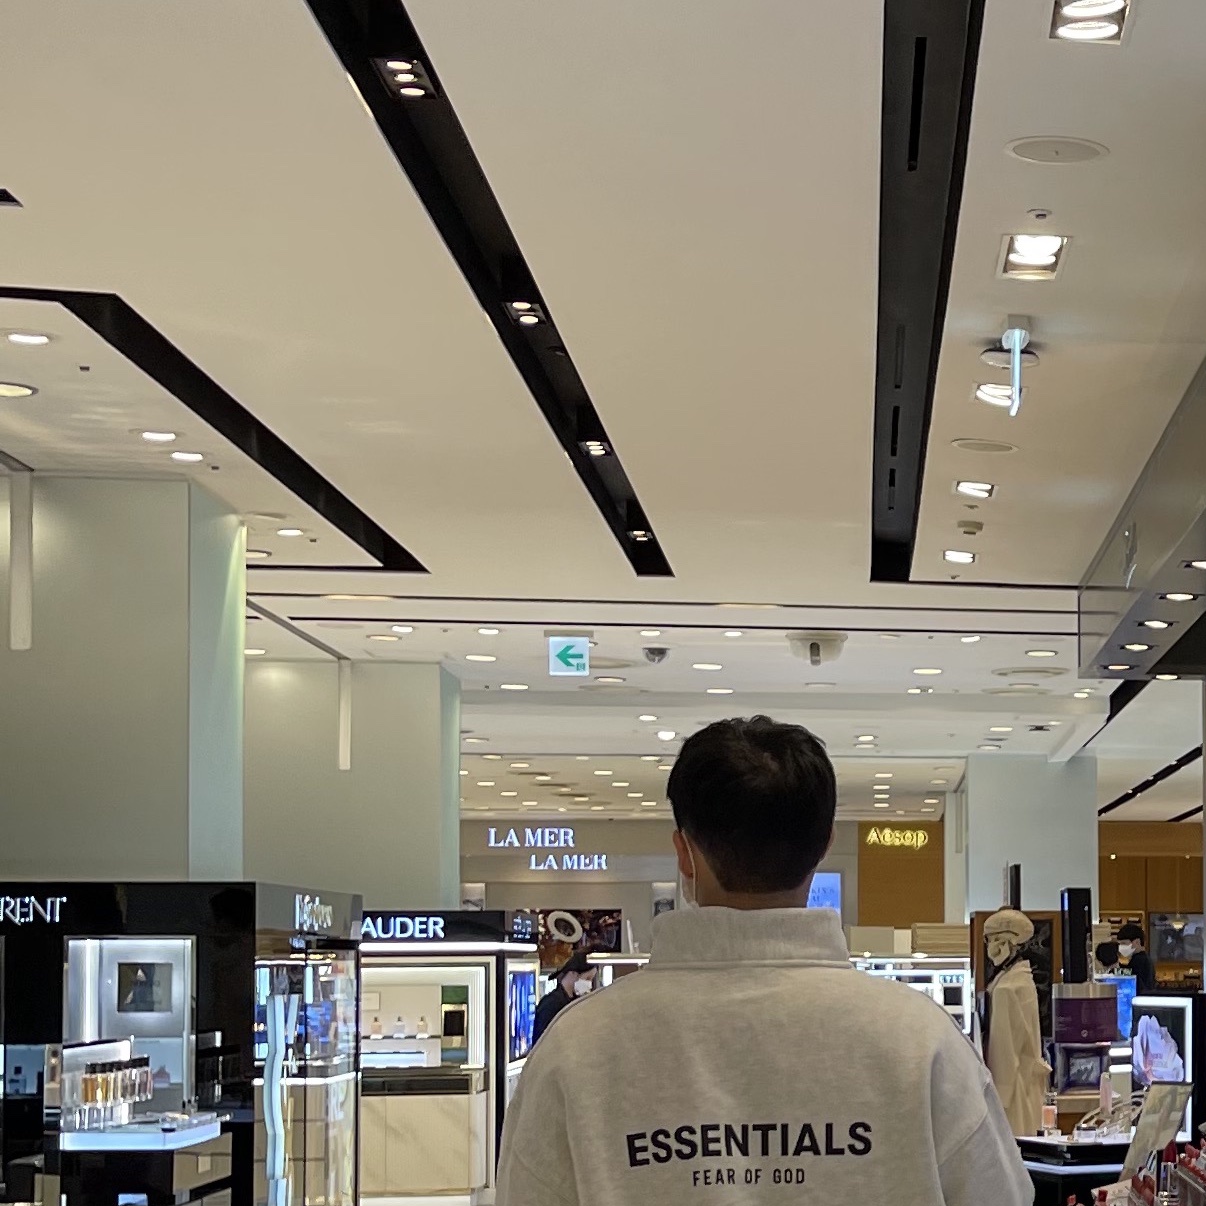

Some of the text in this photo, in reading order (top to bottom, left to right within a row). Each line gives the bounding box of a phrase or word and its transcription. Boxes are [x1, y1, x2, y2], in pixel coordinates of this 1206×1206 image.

[488, 827, 575, 848] LA MER
[529, 854, 558, 870] LA
[361, 916, 445, 939] AUDER
[626, 1121, 873, 1168] ESSENTIALS
[693, 1168, 806, 1187] FEAR OF GOD
